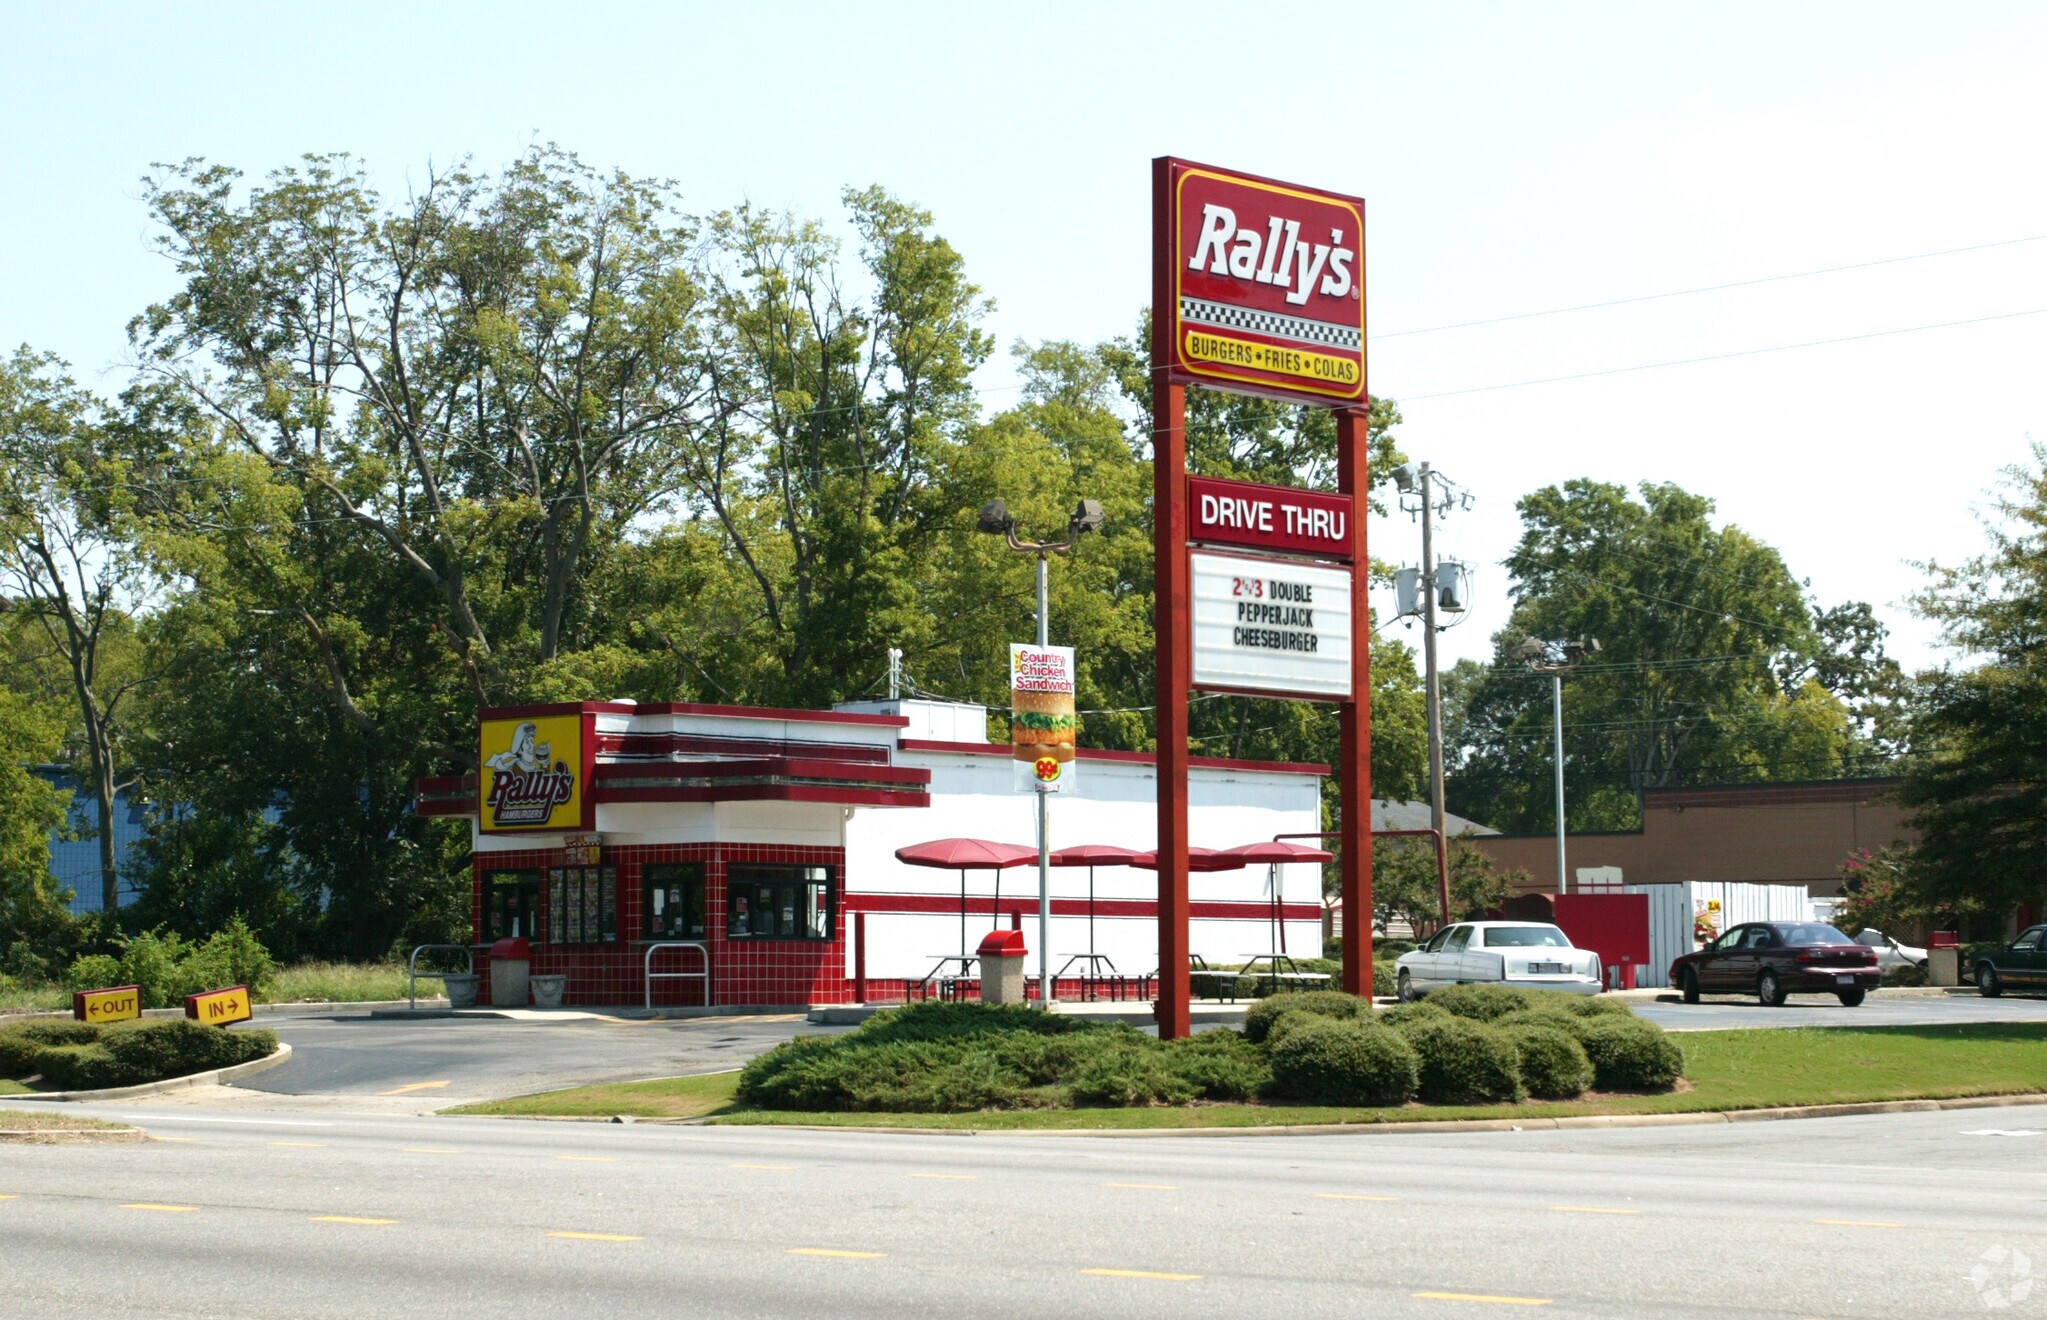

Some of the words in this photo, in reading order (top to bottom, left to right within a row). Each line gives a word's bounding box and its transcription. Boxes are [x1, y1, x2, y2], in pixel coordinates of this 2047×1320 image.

[1188, 203, 1354, 305] Rally's
[1191, 336, 1252, 364] BURGERS
[1265, 349, 1300, 372] FRIES
[1313, 357, 1353, 380] COLAS
[1201, 494, 1273, 532] DRIVE
[1280, 504, 1345, 541] THRU
[1270, 580, 1313, 603] DOUBLE
[1238, 602, 1313, 628] PEPPERJACK
[1234, 626, 1318, 653] CHEESEBURGER
[1020, 650, 1066, 667] Country
[1020, 664, 1066, 677] Chicken
[1016, 676, 1072, 691] Sandwich
[487, 762, 575, 815] Rally's
[500, 809, 544, 820] HAMBURGERS
[103, 998, 135, 1014] OUT
[208, 1001, 225, 1018] IN
